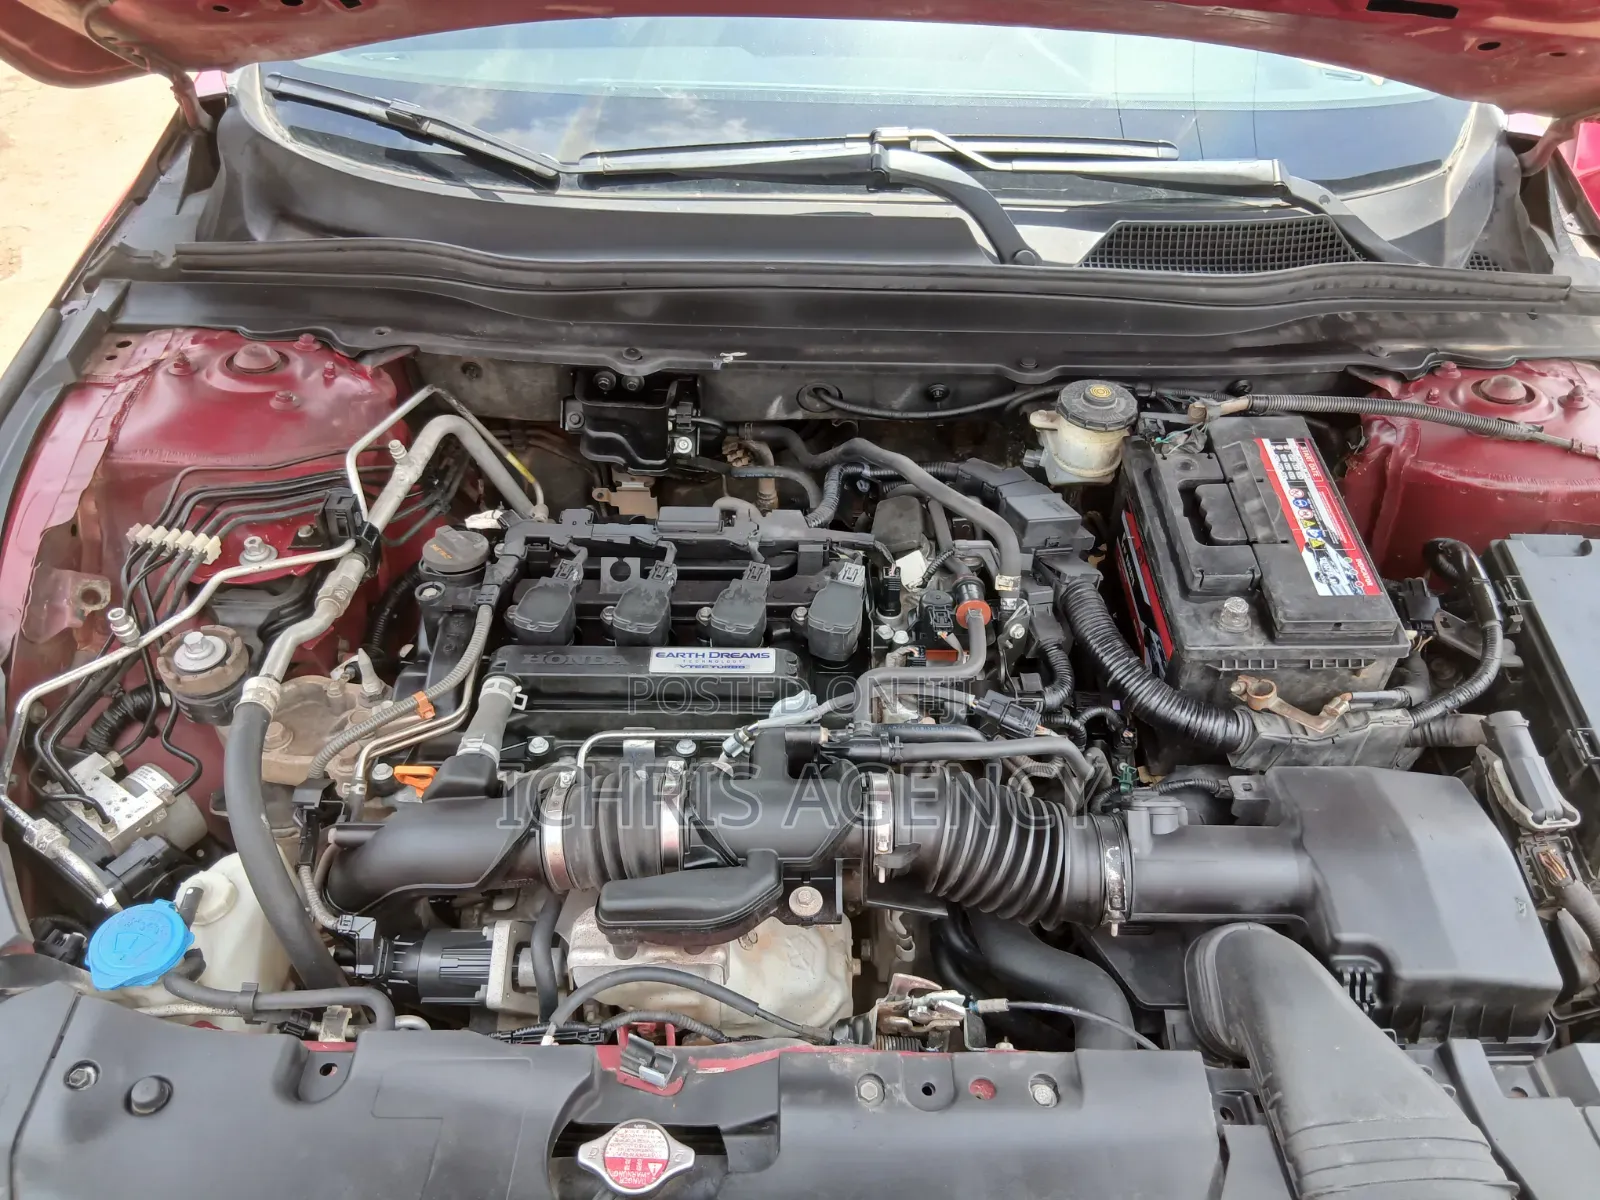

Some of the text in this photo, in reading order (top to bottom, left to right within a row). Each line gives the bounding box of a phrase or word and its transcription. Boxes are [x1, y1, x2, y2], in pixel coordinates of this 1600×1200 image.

[521, 653, 631, 666] HONDA
[655, 651, 771, 659] EARTH DREAMS
